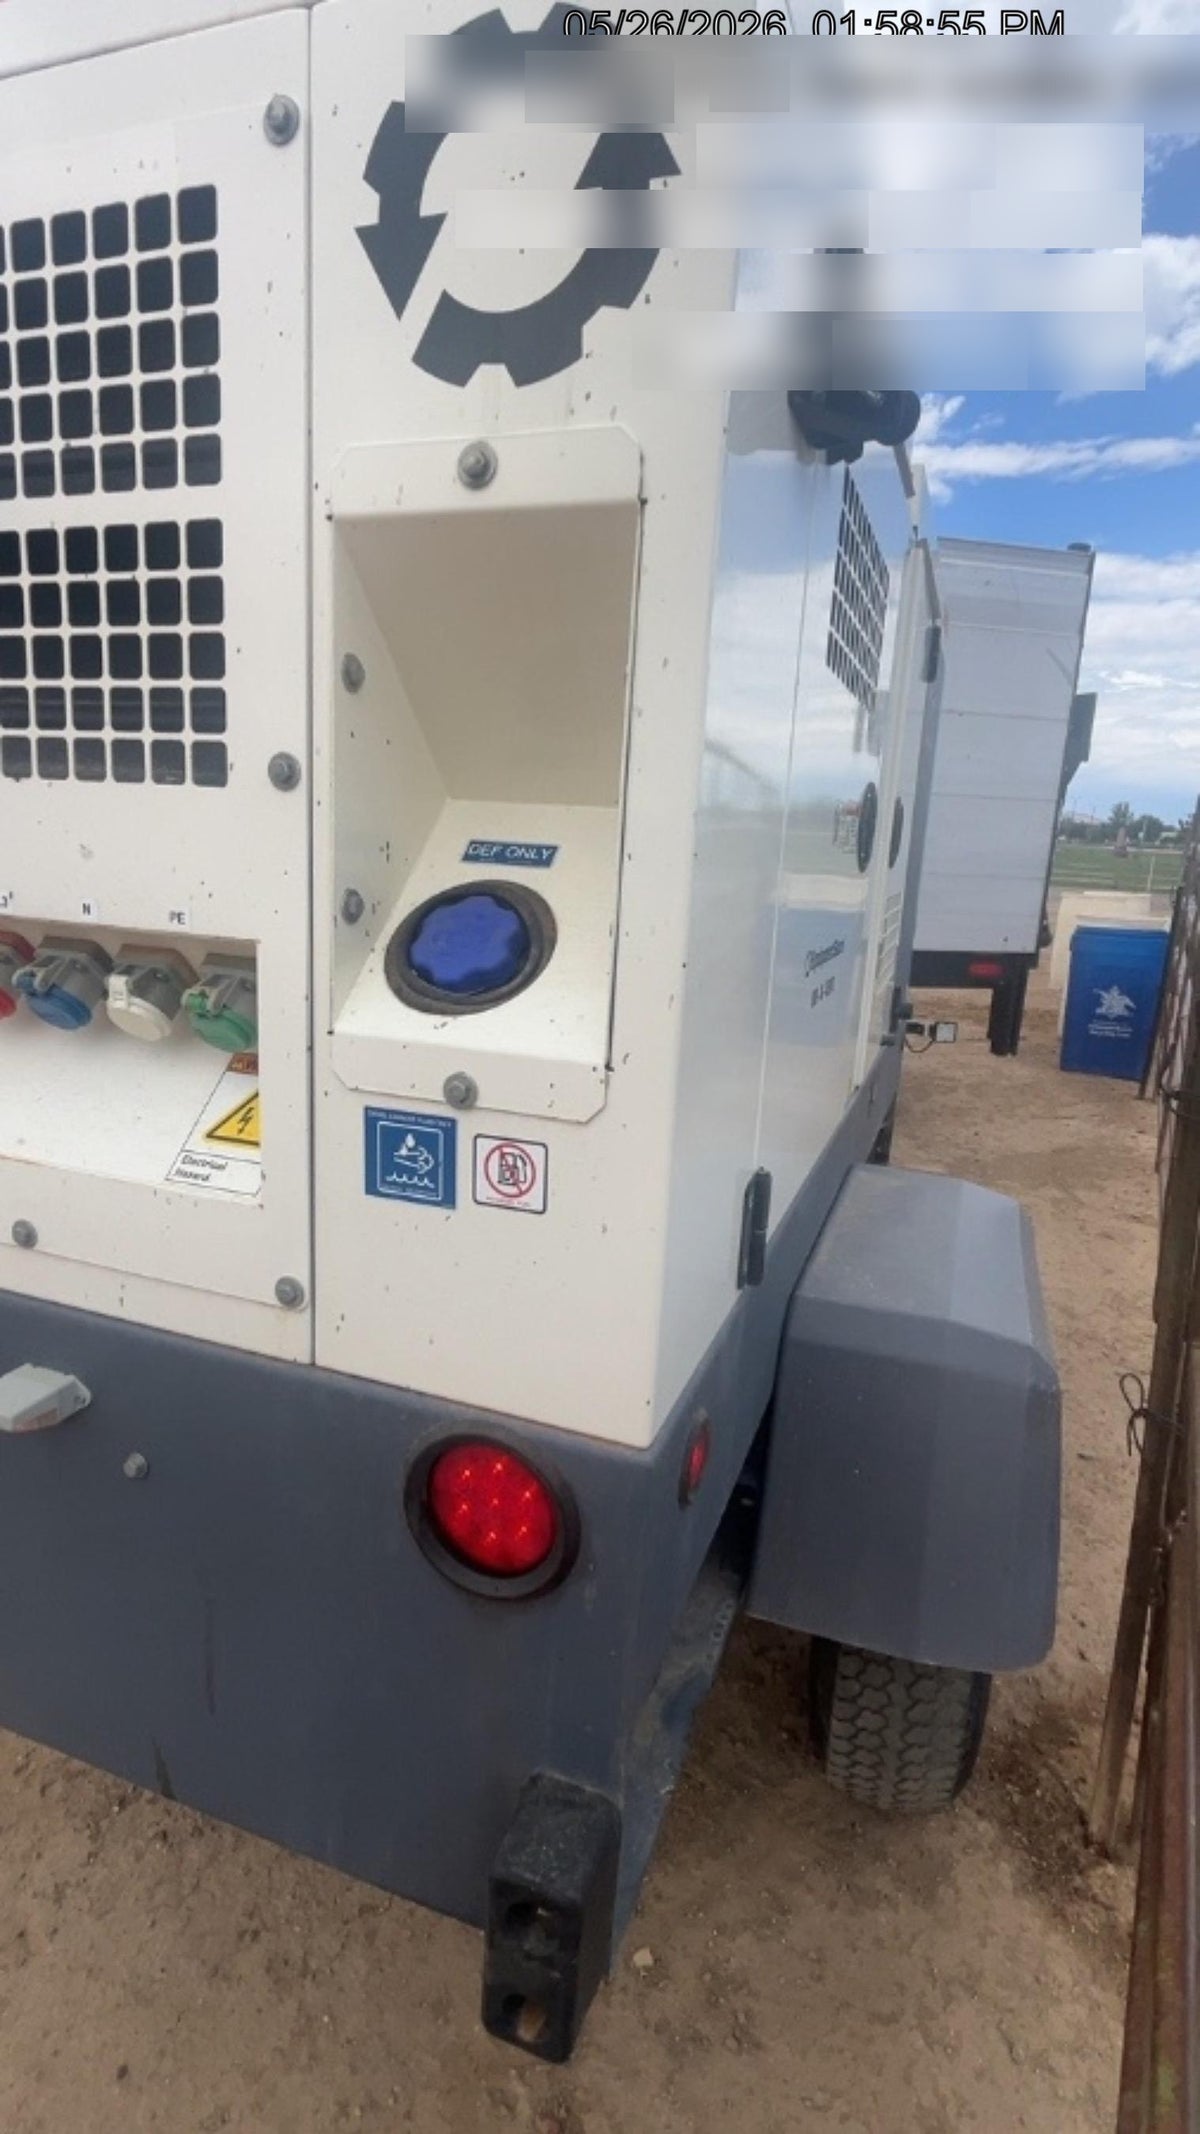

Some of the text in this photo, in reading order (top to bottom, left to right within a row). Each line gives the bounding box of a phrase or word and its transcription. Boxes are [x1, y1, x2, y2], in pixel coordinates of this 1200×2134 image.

[467, 843, 554, 861] DEF ONLY
[82, 903, 91, 915] N
[168, 911, 186, 925] PE
